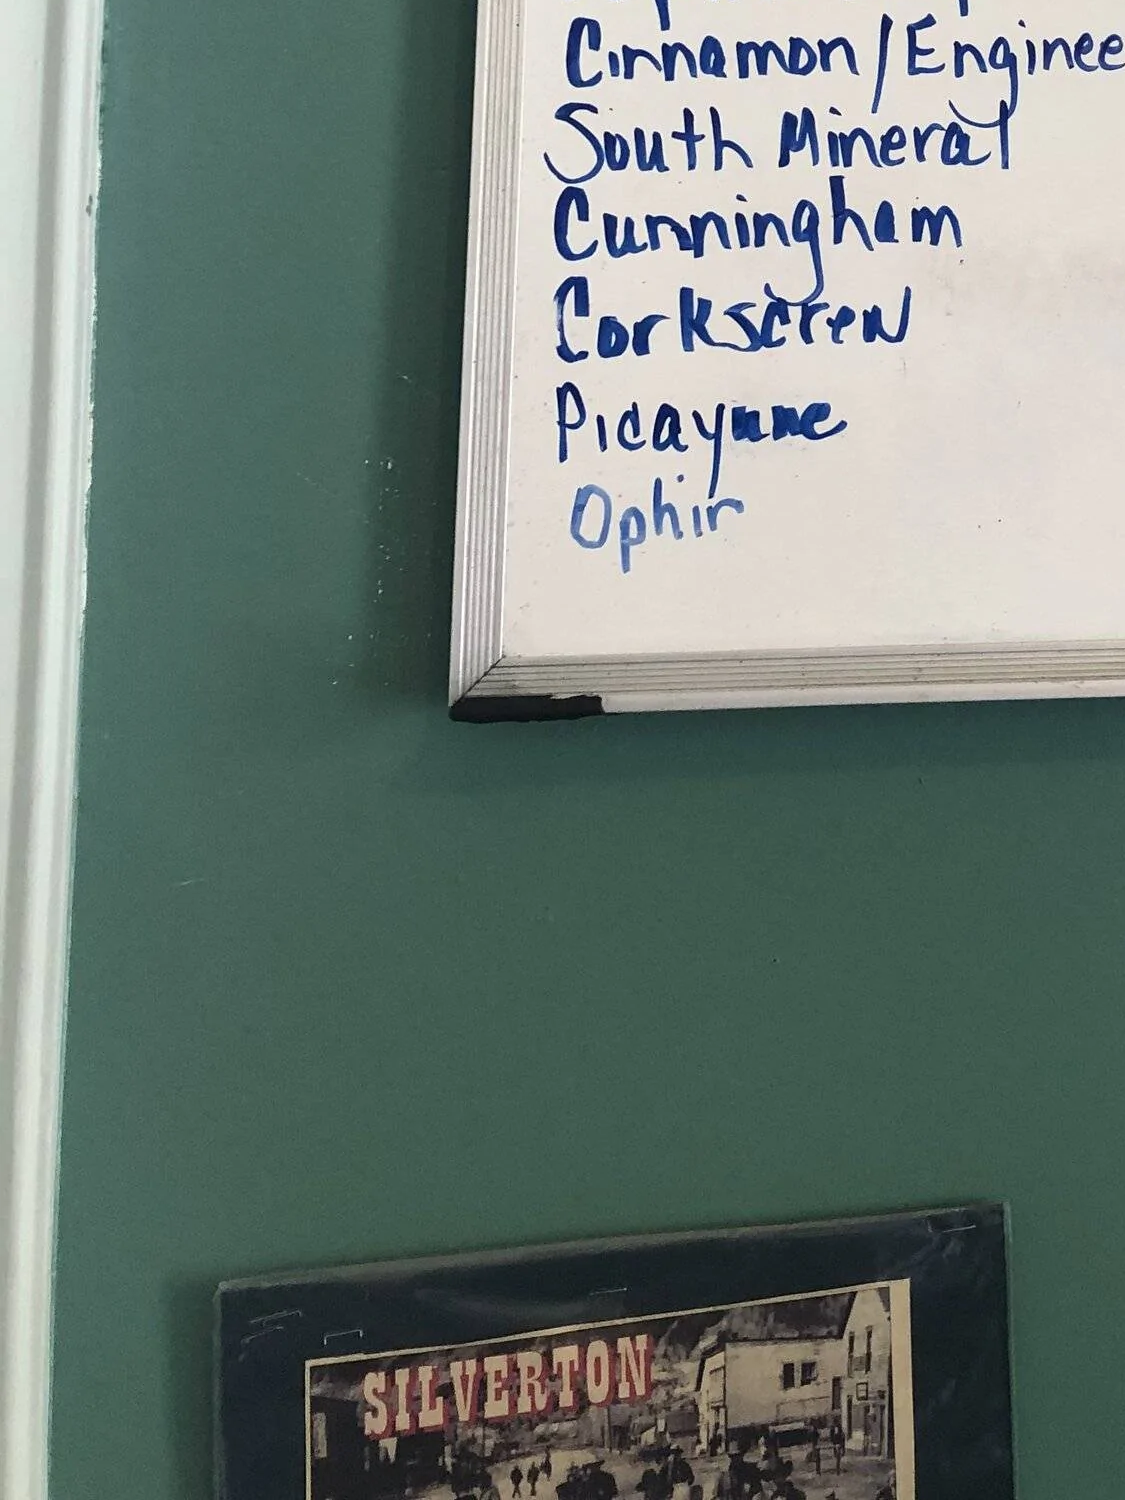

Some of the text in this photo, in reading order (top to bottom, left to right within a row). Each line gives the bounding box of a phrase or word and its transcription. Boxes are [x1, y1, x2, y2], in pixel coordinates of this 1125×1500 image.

[544, 100, 1009, 184] South Mineral
[554, 176, 962, 305] Cunningham
[554, 276, 911, 363] Corkscrew
[570, 475, 744, 574] Ophir
[363, 1333, 653, 1438] SILVERTON
